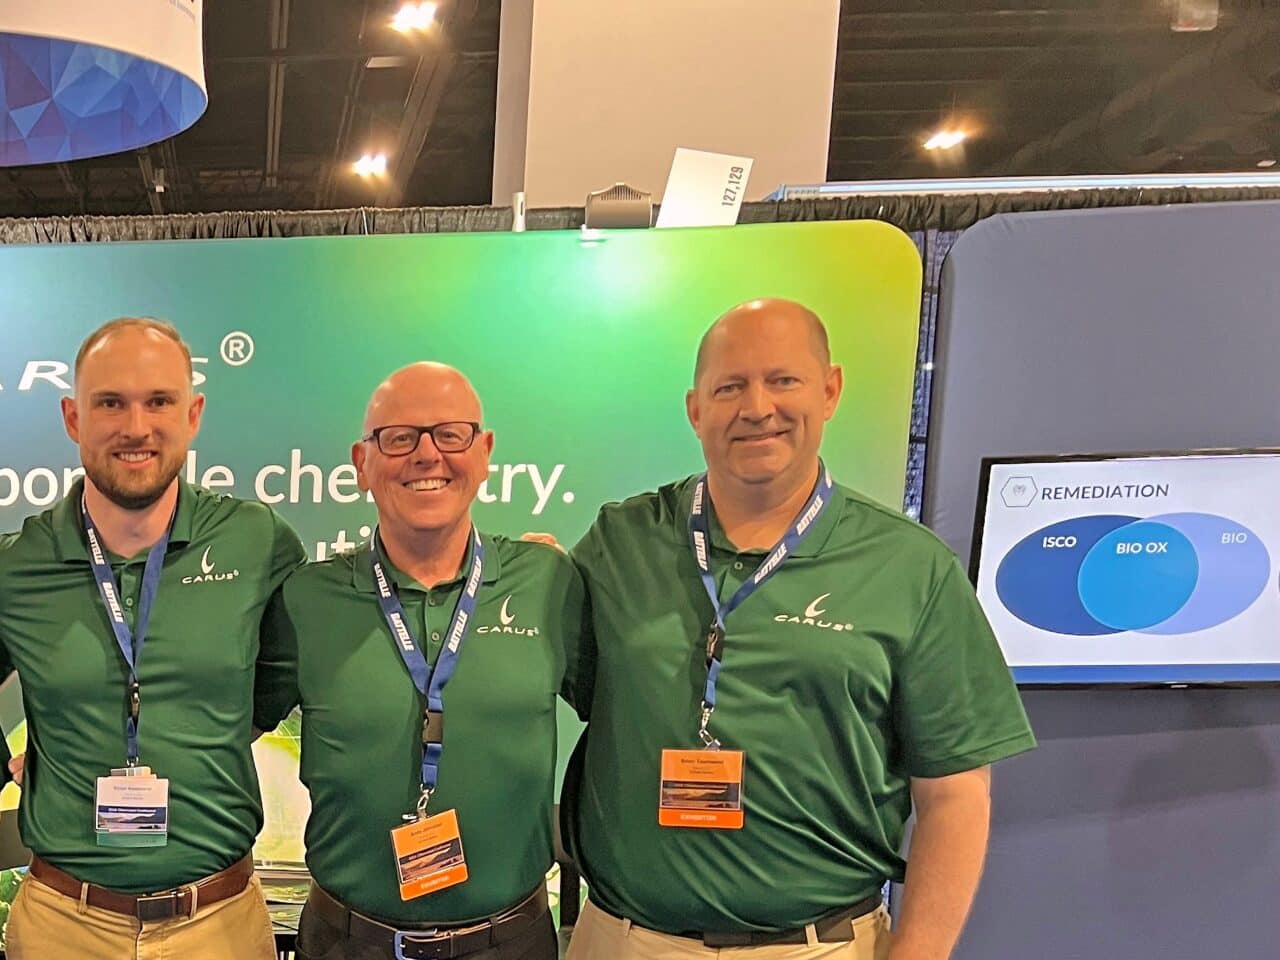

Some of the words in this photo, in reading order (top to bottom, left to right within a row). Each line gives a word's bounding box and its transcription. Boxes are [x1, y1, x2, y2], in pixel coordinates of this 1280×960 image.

[721, 166, 744, 207] 127,129
[254, 447, 575, 516] chetry.
[1041, 484, 1170, 501] REMEDIATION
[1042, 536, 1077, 548] ISCO
[1221, 532, 1248, 544] BIO
[1116, 543, 1143, 554] BIO
[1145, 542, 1168, 553] OX
